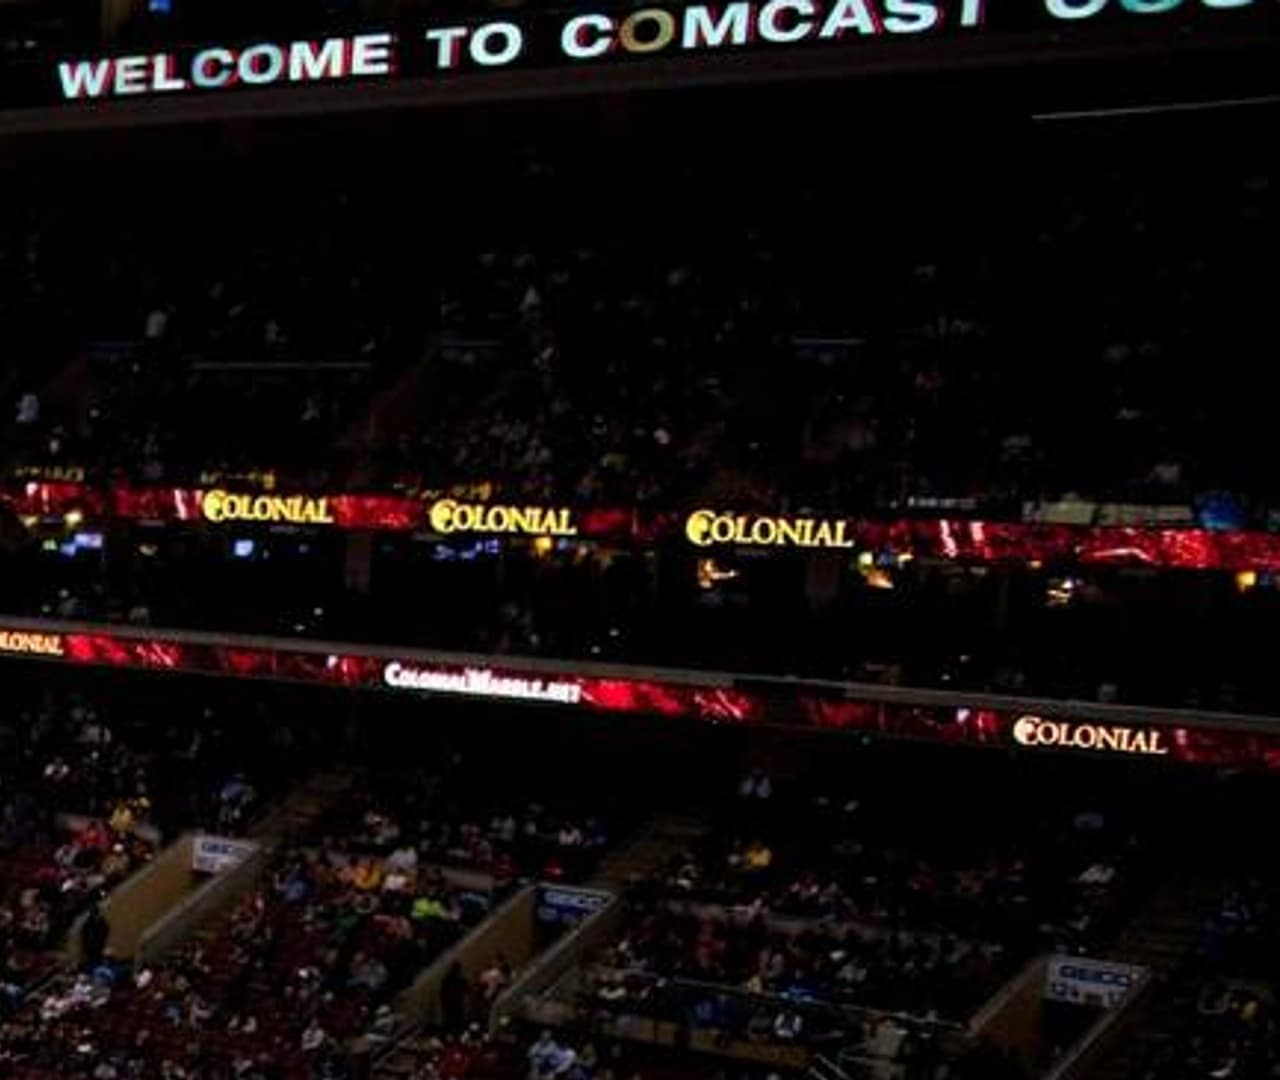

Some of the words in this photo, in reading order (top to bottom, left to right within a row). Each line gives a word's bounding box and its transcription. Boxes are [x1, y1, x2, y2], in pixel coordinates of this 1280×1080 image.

[58, 34, 392, 99] WELCOME
[426, 22, 523, 67] TO
[203, 491, 333, 524] COLONIAL
[430, 499, 578, 536] COLONIAL
[685, 509, 854, 548] COLONIAL
[1013, 715, 1168, 755] COLONIAL
